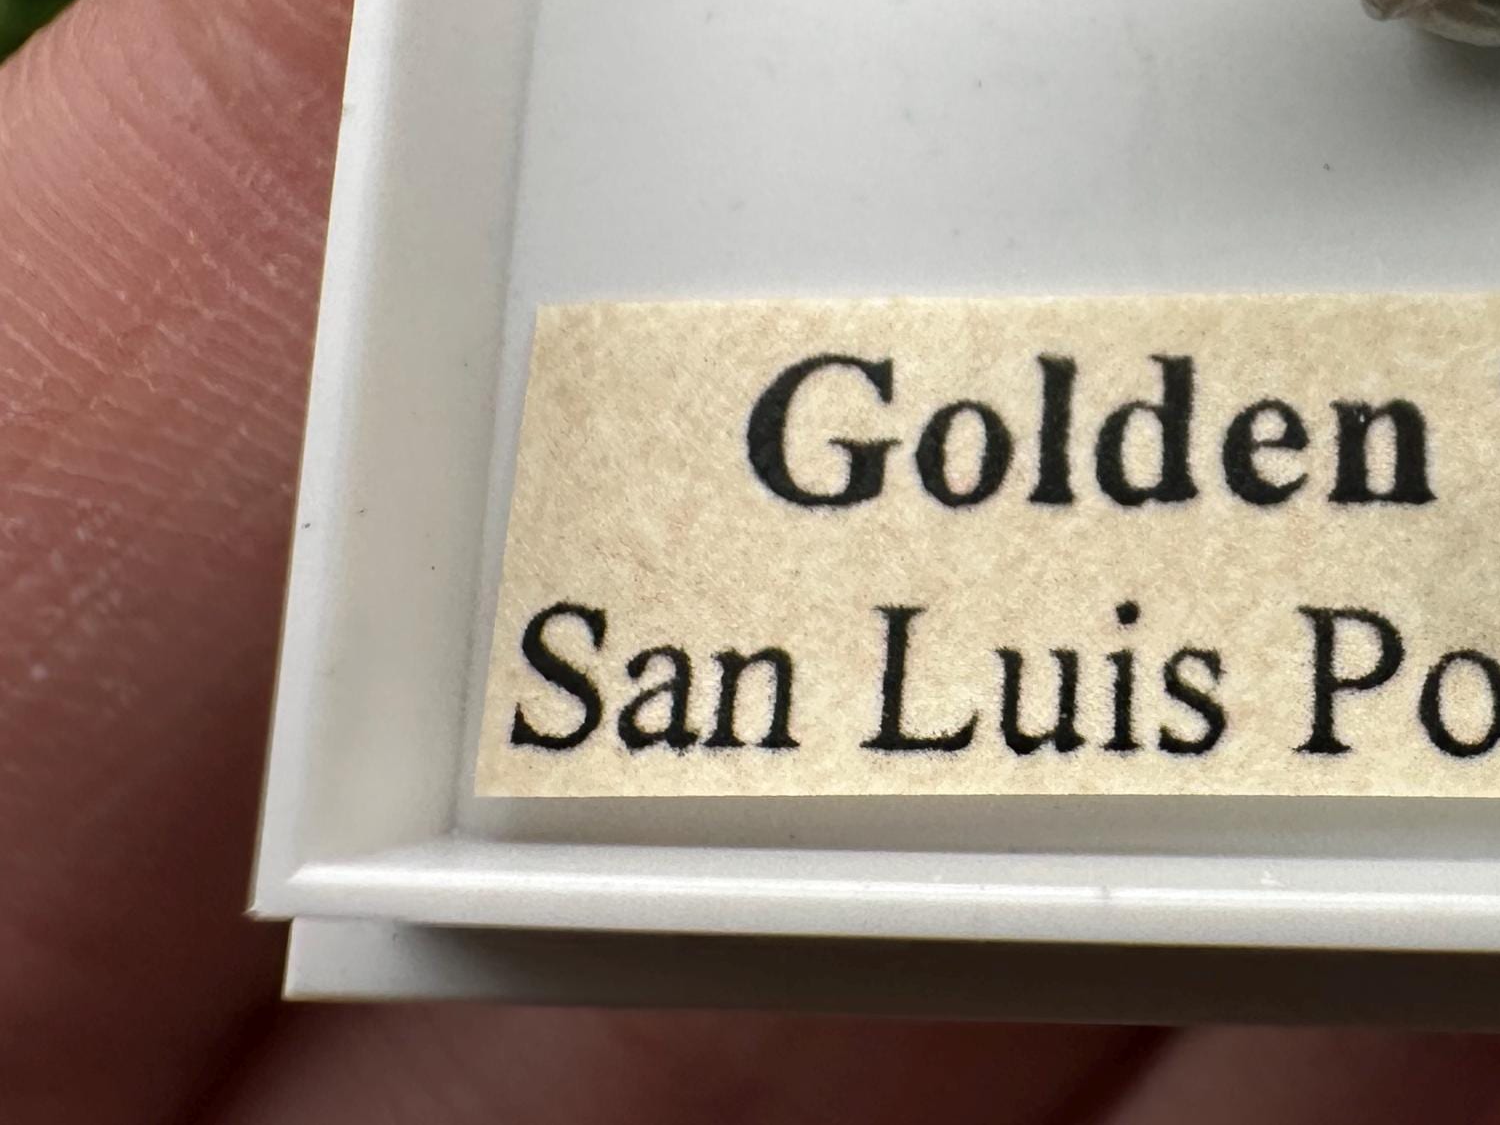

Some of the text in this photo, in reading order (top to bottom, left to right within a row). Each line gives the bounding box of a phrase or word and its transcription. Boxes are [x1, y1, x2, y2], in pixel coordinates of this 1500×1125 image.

[745, 352, 1439, 511] Golden
[508, 599, 802, 759] San
[858, 599, 1229, 759] Luis
